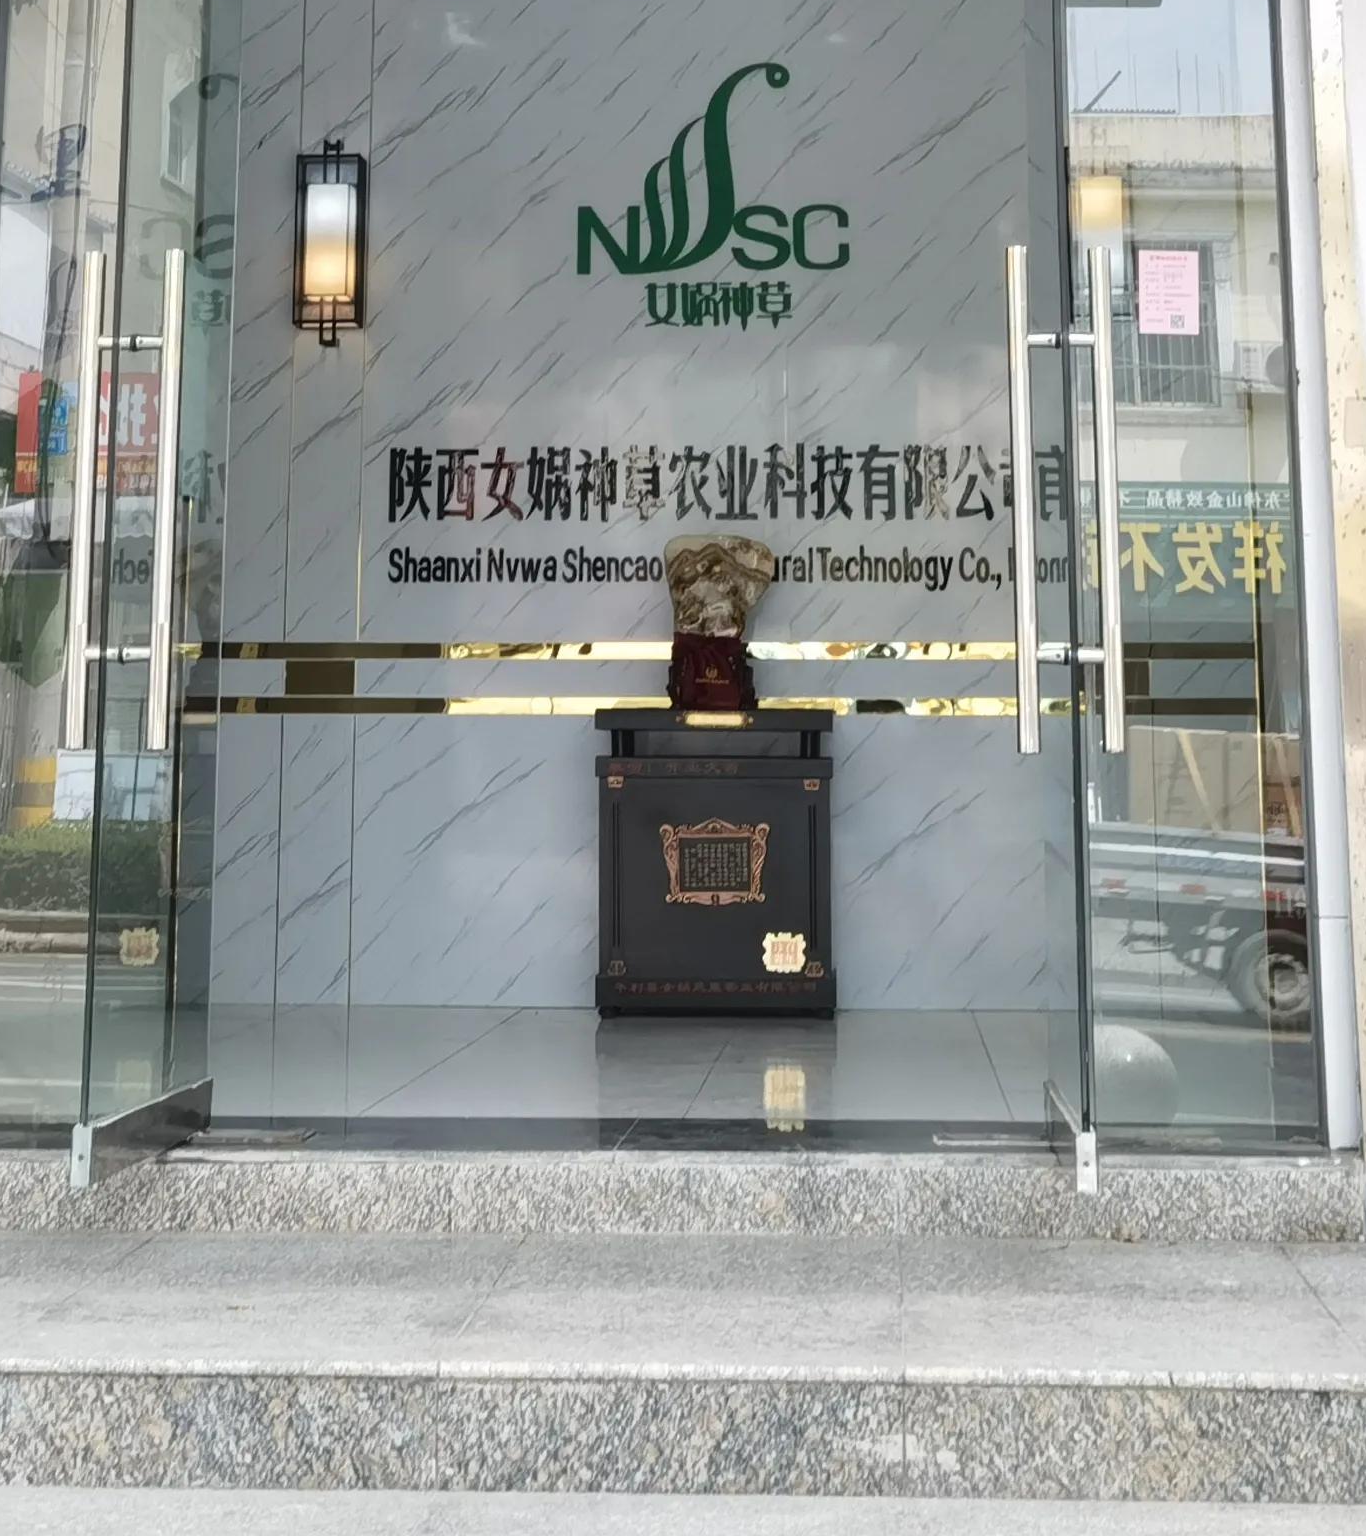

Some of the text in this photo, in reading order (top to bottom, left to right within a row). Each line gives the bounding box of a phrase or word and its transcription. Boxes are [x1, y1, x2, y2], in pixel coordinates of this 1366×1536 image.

[388, 547, 481, 583] Shaanxi
[487, 548, 557, 583] Nvwa
[562, 546, 663, 583] Shencao
[816, 545, 953, 591] Technology
